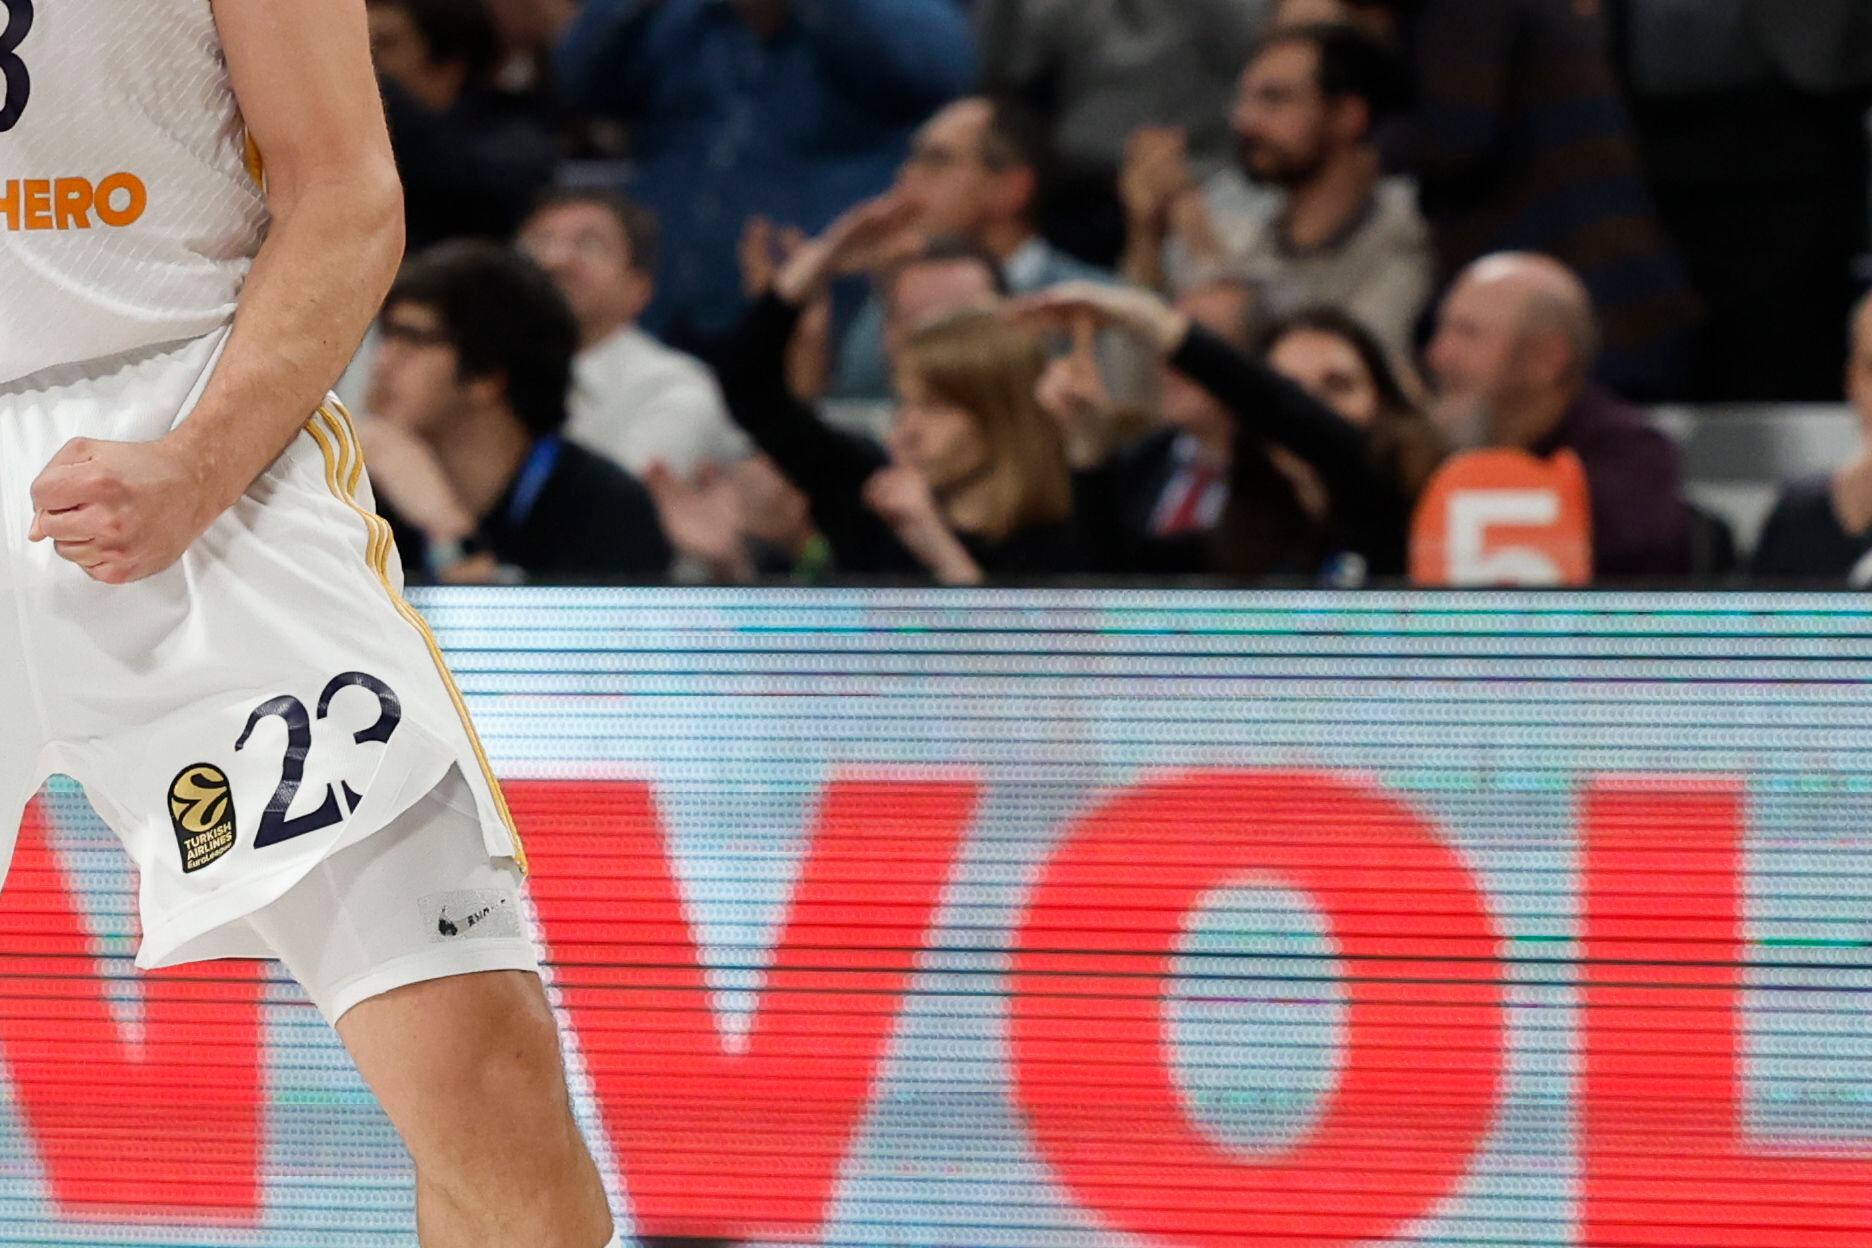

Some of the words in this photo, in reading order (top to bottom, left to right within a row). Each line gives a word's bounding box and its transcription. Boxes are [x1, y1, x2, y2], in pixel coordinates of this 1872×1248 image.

[1448, 489, 1562, 587] 5
[183, 821, 232, 850] TURKISH
[187, 833, 232, 860] AIRLINES
[500, 762, 1872, 1248] VOL
